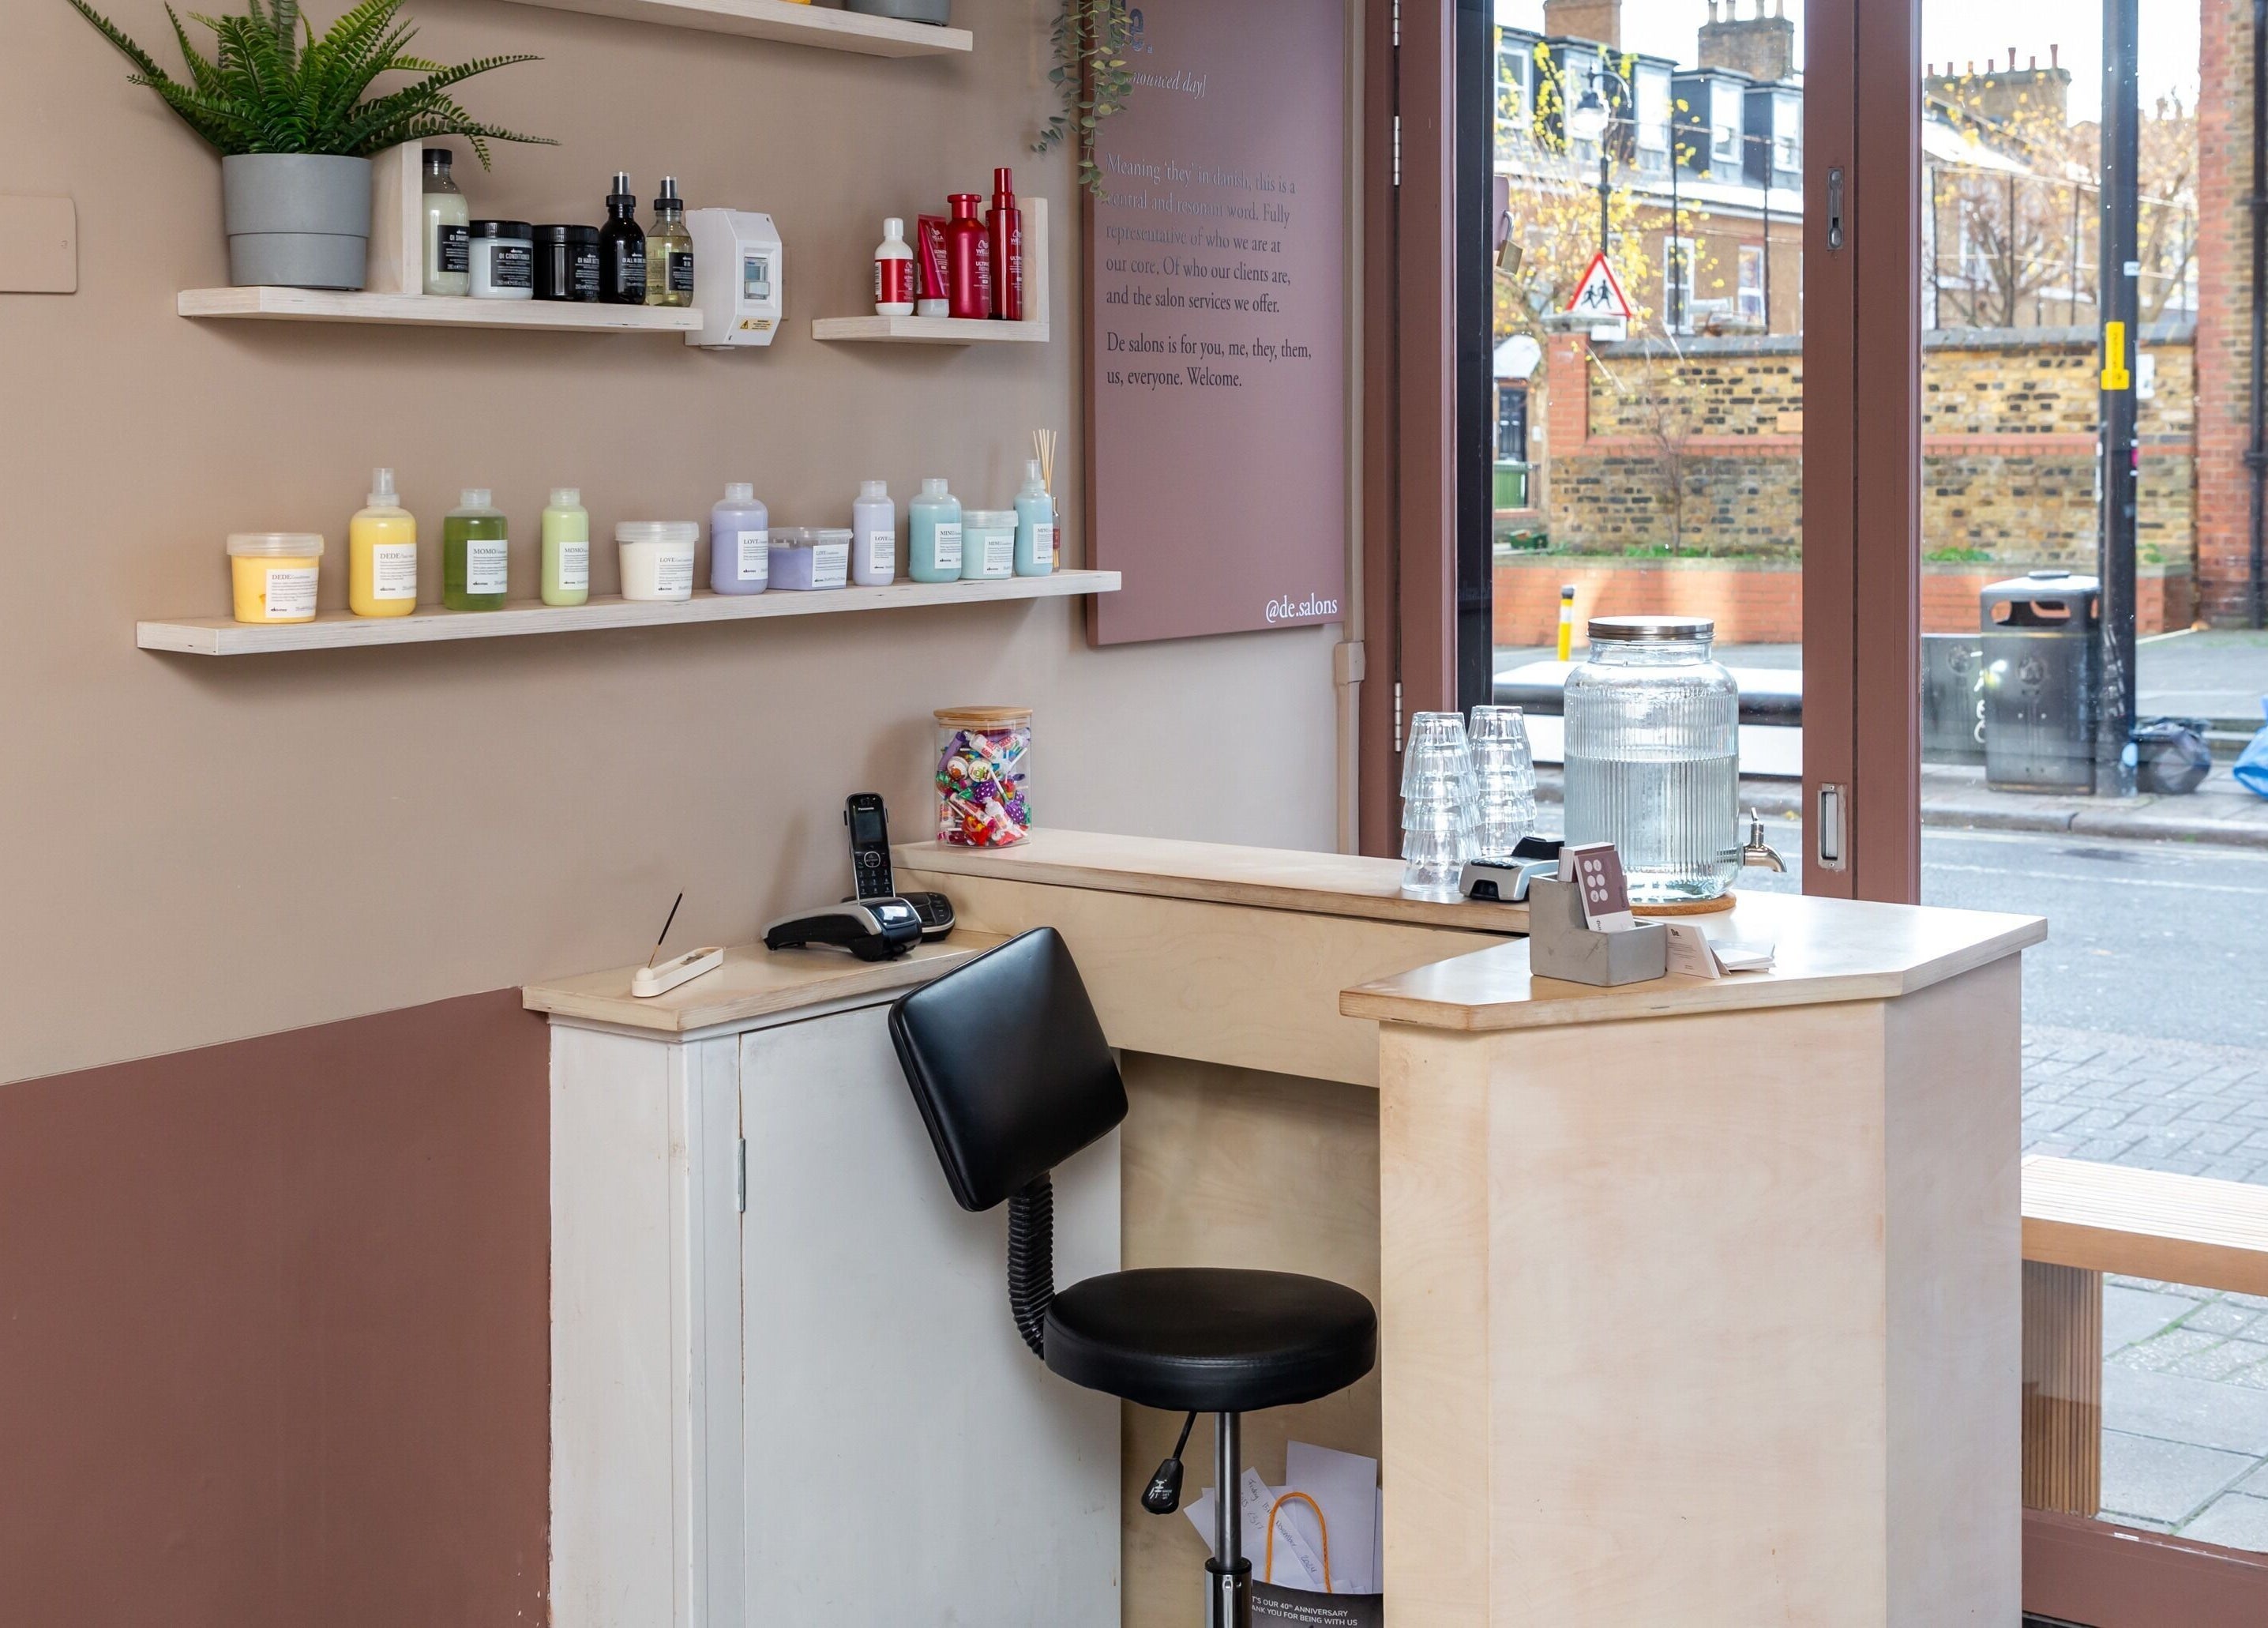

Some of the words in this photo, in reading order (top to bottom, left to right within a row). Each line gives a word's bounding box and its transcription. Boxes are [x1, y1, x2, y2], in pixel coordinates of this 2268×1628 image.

[1125, 70, 1180, 90] nounced
[1182, 72, 1207, 100] day]
[1106, 152, 1160, 185] Meaning
[1197, 166, 1209, 183] in
[1212, 166, 1252, 191] danish,
[1256, 172, 1275, 191] this
[1279, 175, 1287, 193] is
[1290, 182, 1296, 194] a
[1107, 190, 1147, 209] central
[1151, 192, 1173, 212] and
[1177, 201, 1222, 216] resonant
[1226, 202, 1259, 220] word.
[1264, 203, 1290, 229] Fully
[1106, 226, 1186, 245] representative
[1191, 227, 1203, 246] of
[1206, 228, 1230, 248] who
[1234, 237, 1248, 250] we
[1252, 237, 1267, 252] are
[1271, 239, 1282, 253] at
[1106, 258, 1127, 272] our
[1131, 260, 1159, 275] core.
[1163, 255, 1181, 275] Of
[1183, 258, 1207, 277] who
[1211, 266, 1230, 279] our
[1234, 261, 1269, 282] clients
[1271, 271, 1290, 285] are,
[1106, 284, 1128, 304] and
[1133, 286, 1151, 306] the
[1155, 287, 1185, 307] salon
[1188, 291, 1230, 310] services
[1234, 299, 1249, 311] we
[1252, 293, 1279, 313] offer.
[1106, 332, 1125, 352] De
[1128, 333, 1164, 353] salons
[1168, 336, 1177, 353] is
[1181, 333, 1197, 354] for
[1200, 341, 1225, 360] you,
[1229, 343, 1249, 358] me,
[1252, 337, 1278, 363] they,
[1281, 338, 1311, 360] them,
[1106, 370, 1124, 387] us,
[1128, 371, 1183, 391] everyone.
[1187, 367, 1242, 387] Welcome.
[1266, 592, 1338, 623] @de.salons
[1275, 1520, 1297, 1547] November
[1301, 1555, 1317, 1573] 2024
[1252, 1596, 1262, 1604] T'S
[1263, 1599, 1279, 1608] OUR
[1294, 1606, 1349, 1618] ANNIVERSARY
[1267, 1608, 1282, 1617] YOU
[1284, 1611, 1298, 1620] FOR
[1300, 1615, 1323, 1624] BEING
